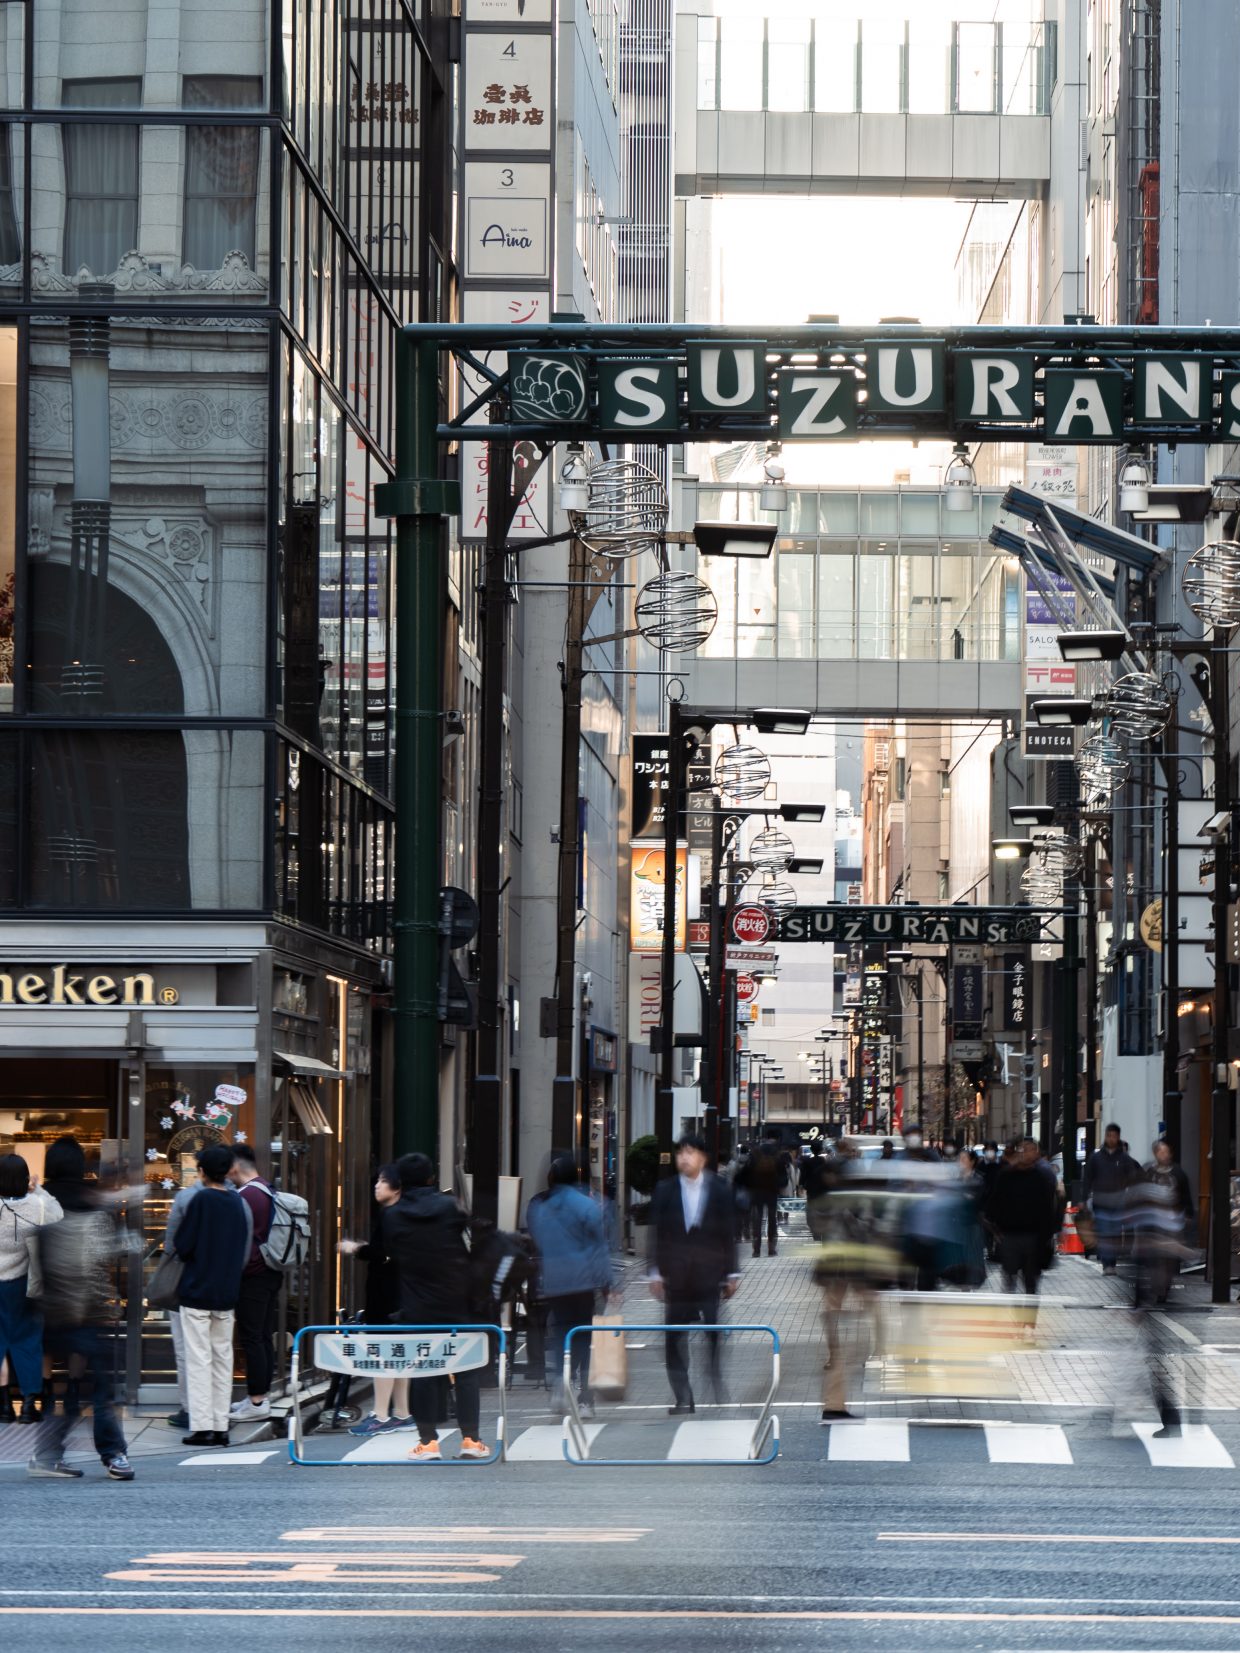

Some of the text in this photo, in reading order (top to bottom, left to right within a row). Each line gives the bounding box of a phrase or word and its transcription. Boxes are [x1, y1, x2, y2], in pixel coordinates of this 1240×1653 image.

[502, 40, 516, 57] 4
[472, 107, 545, 126] 珈琲店
[501, 168, 514, 187] 3
[480, 224, 533, 249] Aina
[613, 348, 1200, 436] SUZURAN
[1028, 735, 1072, 746] ENOTECA
[650, 749, 669, 759] 銀座
[648, 780, 670, 790] 本店
[736, 917, 766, 933] 消火栓
[786, 912, 1008, 943] SUZURAN St
[1012, 961, 1025, 1023] 金子眼鏡店
[342, 1342, 457, 1357] 車両通行止
